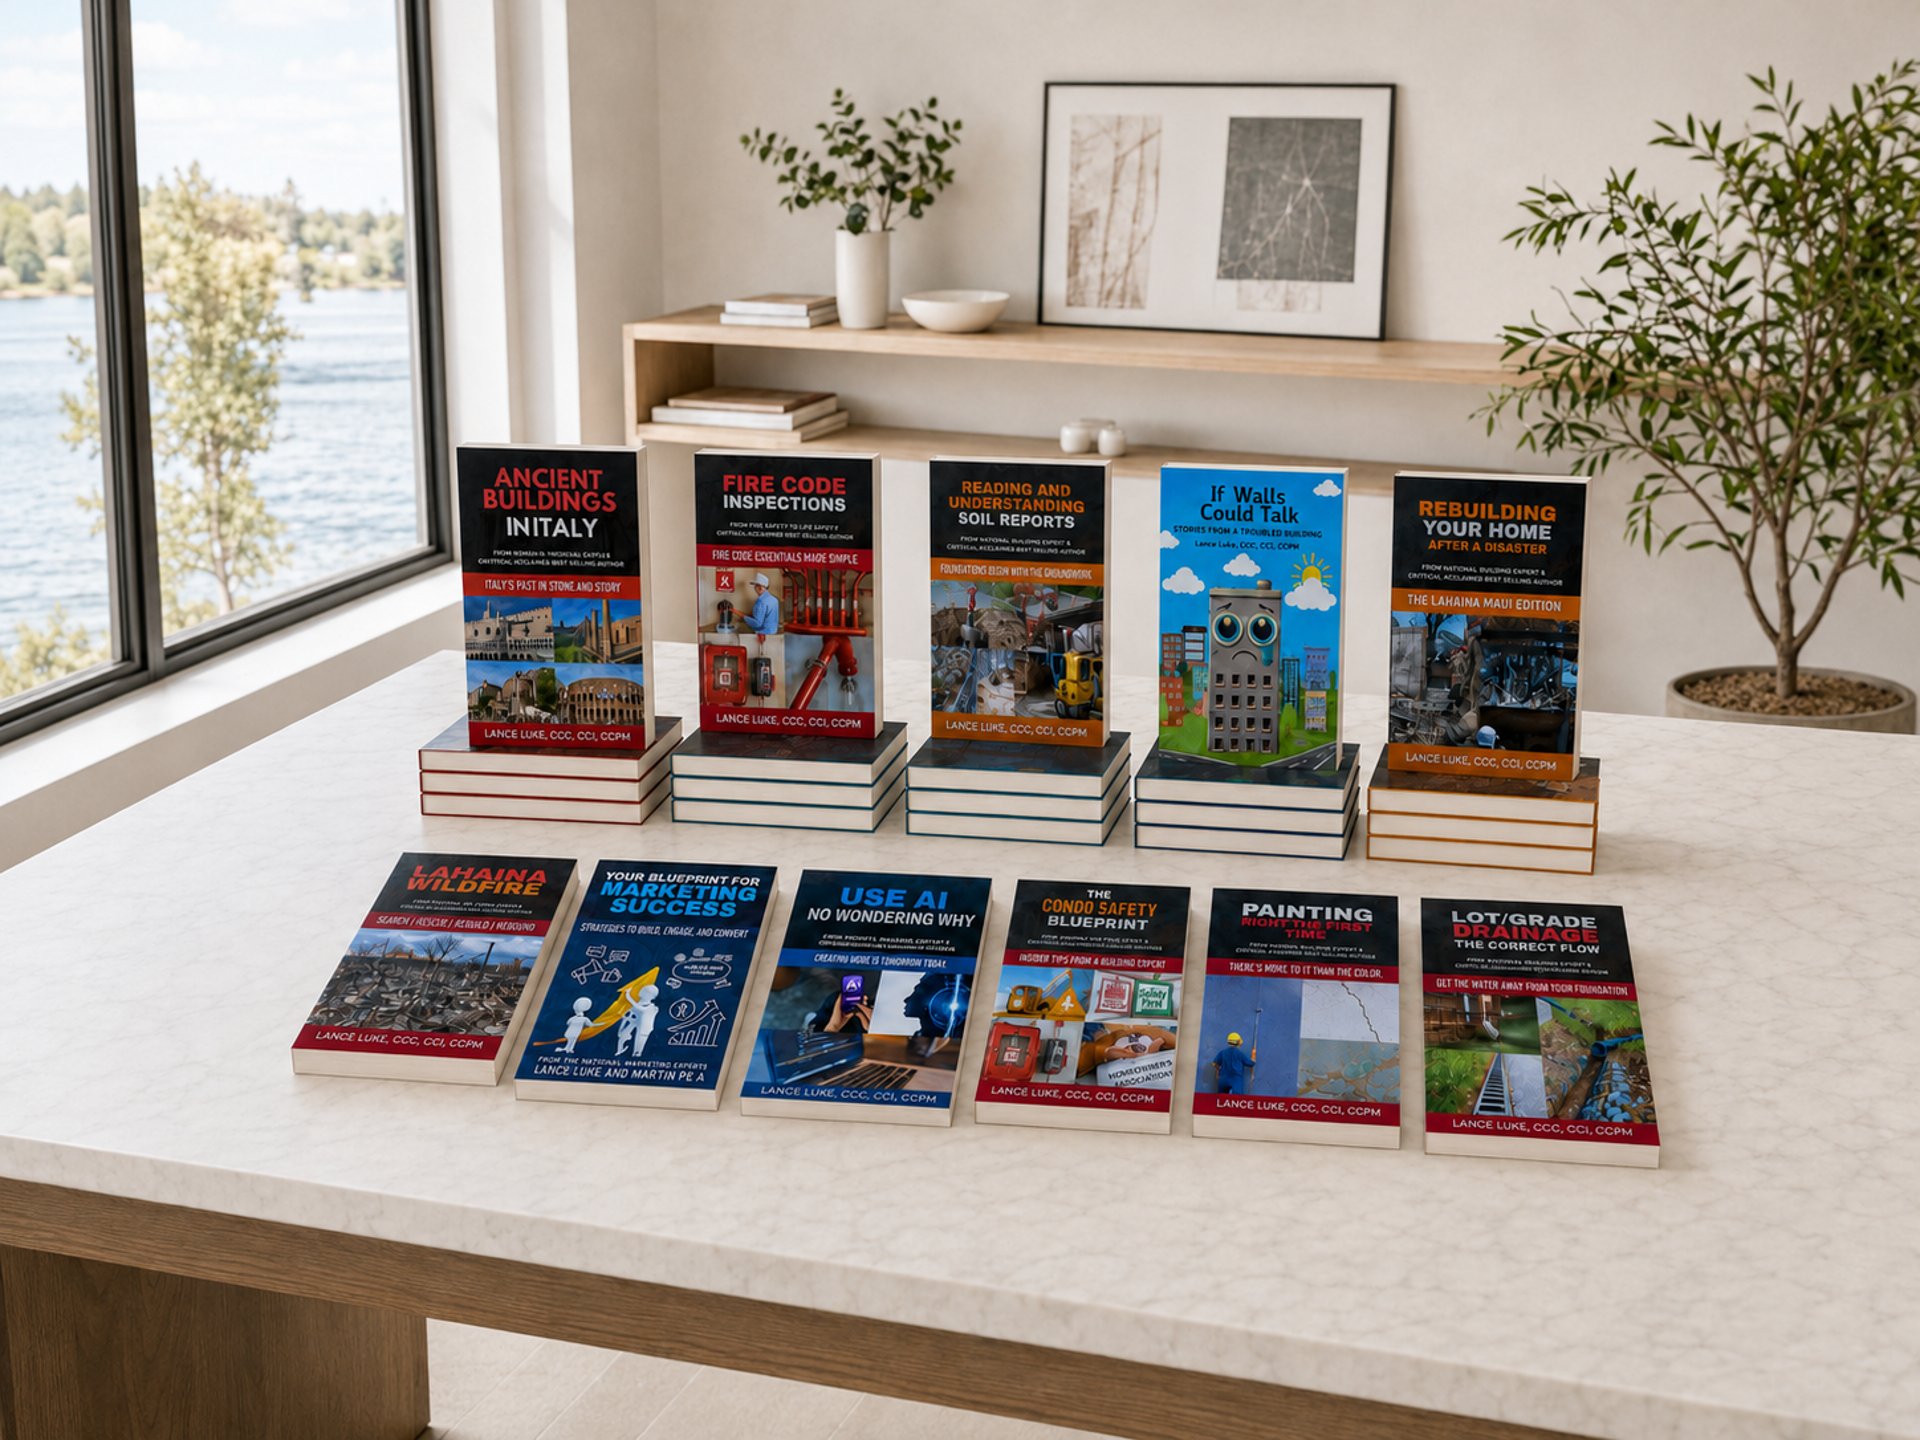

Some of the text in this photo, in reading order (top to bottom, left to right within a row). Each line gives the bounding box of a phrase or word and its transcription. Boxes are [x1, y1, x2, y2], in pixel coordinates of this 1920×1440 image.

[494, 467, 603, 489] ANCIENT
[723, 474, 846, 495] FIRE CODE
[962, 481, 1071, 497] READING AND
[1211, 485, 1286, 504] If Walls
[483, 488, 617, 512] BUILDINGS
[723, 495, 846, 512] INSPECTIONS
[948, 497, 1085, 513] UNDERSTANDING
[1200, 504, 1299, 524] Could Talk
[1419, 500, 1557, 521] REBUILDING
[958, 512, 1075, 529] SOIL REPORTS
[1423, 519, 1552, 540] YOUR HOME
[1429, 539, 1547, 554] AFTER A DISASTER
[595, 582, 621, 592] STORY
[1408, 594, 1562, 611] THE LAHAINA MAUI EDITION
[716, 713, 861, 728] LANCE LUKE, CCC, CCI, CCPM
[946, 720, 978, 731] LANCE
[1009, 724, 1033, 735] CCC,
[485, 729, 518, 738] LANCE
[550, 731, 575, 741] CCC,
[577, 731, 598, 741] CCI,
[601, 732, 631, 741] CCPM
[1406, 752, 1557, 770] LANCE LUKE, CCC, CCI, CCPM
[413, 865, 547, 883] LAHAINA
[606, 872, 760, 886] YOUR BLUEPRINT FOR
[407, 878, 542, 896] WILDFIRE
[601, 882, 757, 901] MARKETING
[1087, 889, 1112, 899] THE
[841, 887, 948, 910] USE AI
[610, 898, 736, 917] SUCCESS
[1042, 898, 1158, 917] CONDO SAFETY
[1242, 903, 1374, 922] PAINTING
[807, 907, 976, 928] NO WONDERING WHY
[1048, 915, 1149, 930] BLUEPRINT
[1452, 911, 1597, 929] LOT/GRADE
[1285, 930, 1326, 939] TIME
[1325, 921, 1373, 932] FIRST
[1453, 924, 1599, 943] DRAINAGE
[1454, 940, 1599, 954] THE CORRECT FLOW
[316, 1032, 356, 1041] LANCE
[393, 1036, 419, 1046] CCC,
[423, 1038, 446, 1047] CCI,
[449, 1039, 483, 1049] CCPM
[573, 1066, 602, 1077] LUKE
[605, 1068, 629, 1079] AND
[631, 1070, 676, 1081] MARTIN
[761, 1086, 937, 1103] LANCE LUKE, CCC, CCI, CCPM
[991, 1086, 1155, 1103] LANCE LUKE, CCC, CCI, CCPM
[1216, 1099, 1381, 1117] LANCE LUKE, CCC, CCI, CCPM
[1452, 1119, 1633, 1136] LANCE LUKE, CCC, CCI, CCPM
